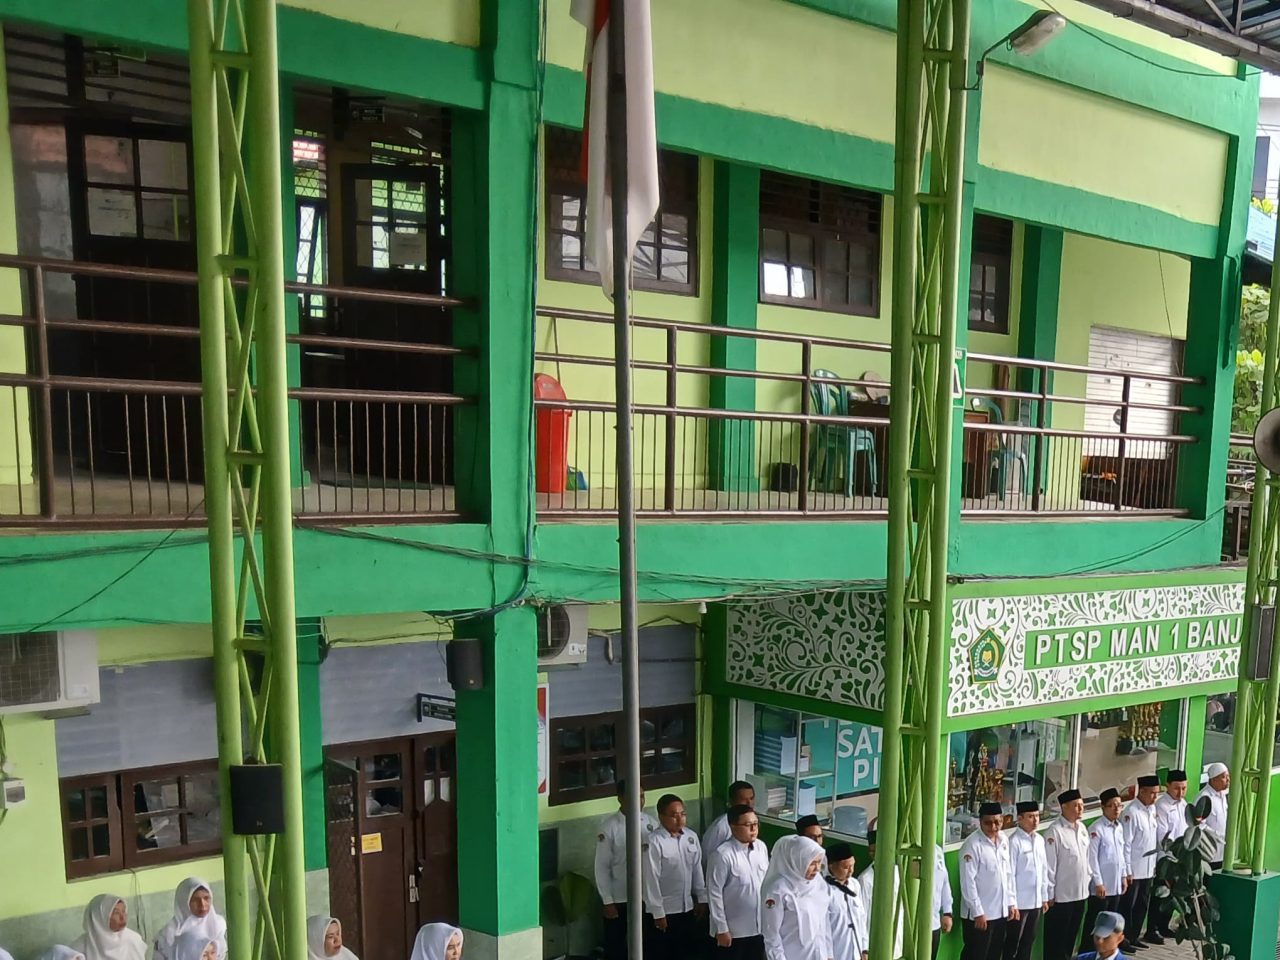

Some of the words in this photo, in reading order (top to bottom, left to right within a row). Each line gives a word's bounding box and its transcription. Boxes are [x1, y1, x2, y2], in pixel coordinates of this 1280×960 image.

[1036, 629, 1101, 666] PTSP
[1110, 623, 1161, 658] MAN
[1170, 622, 1180, 651] 1
